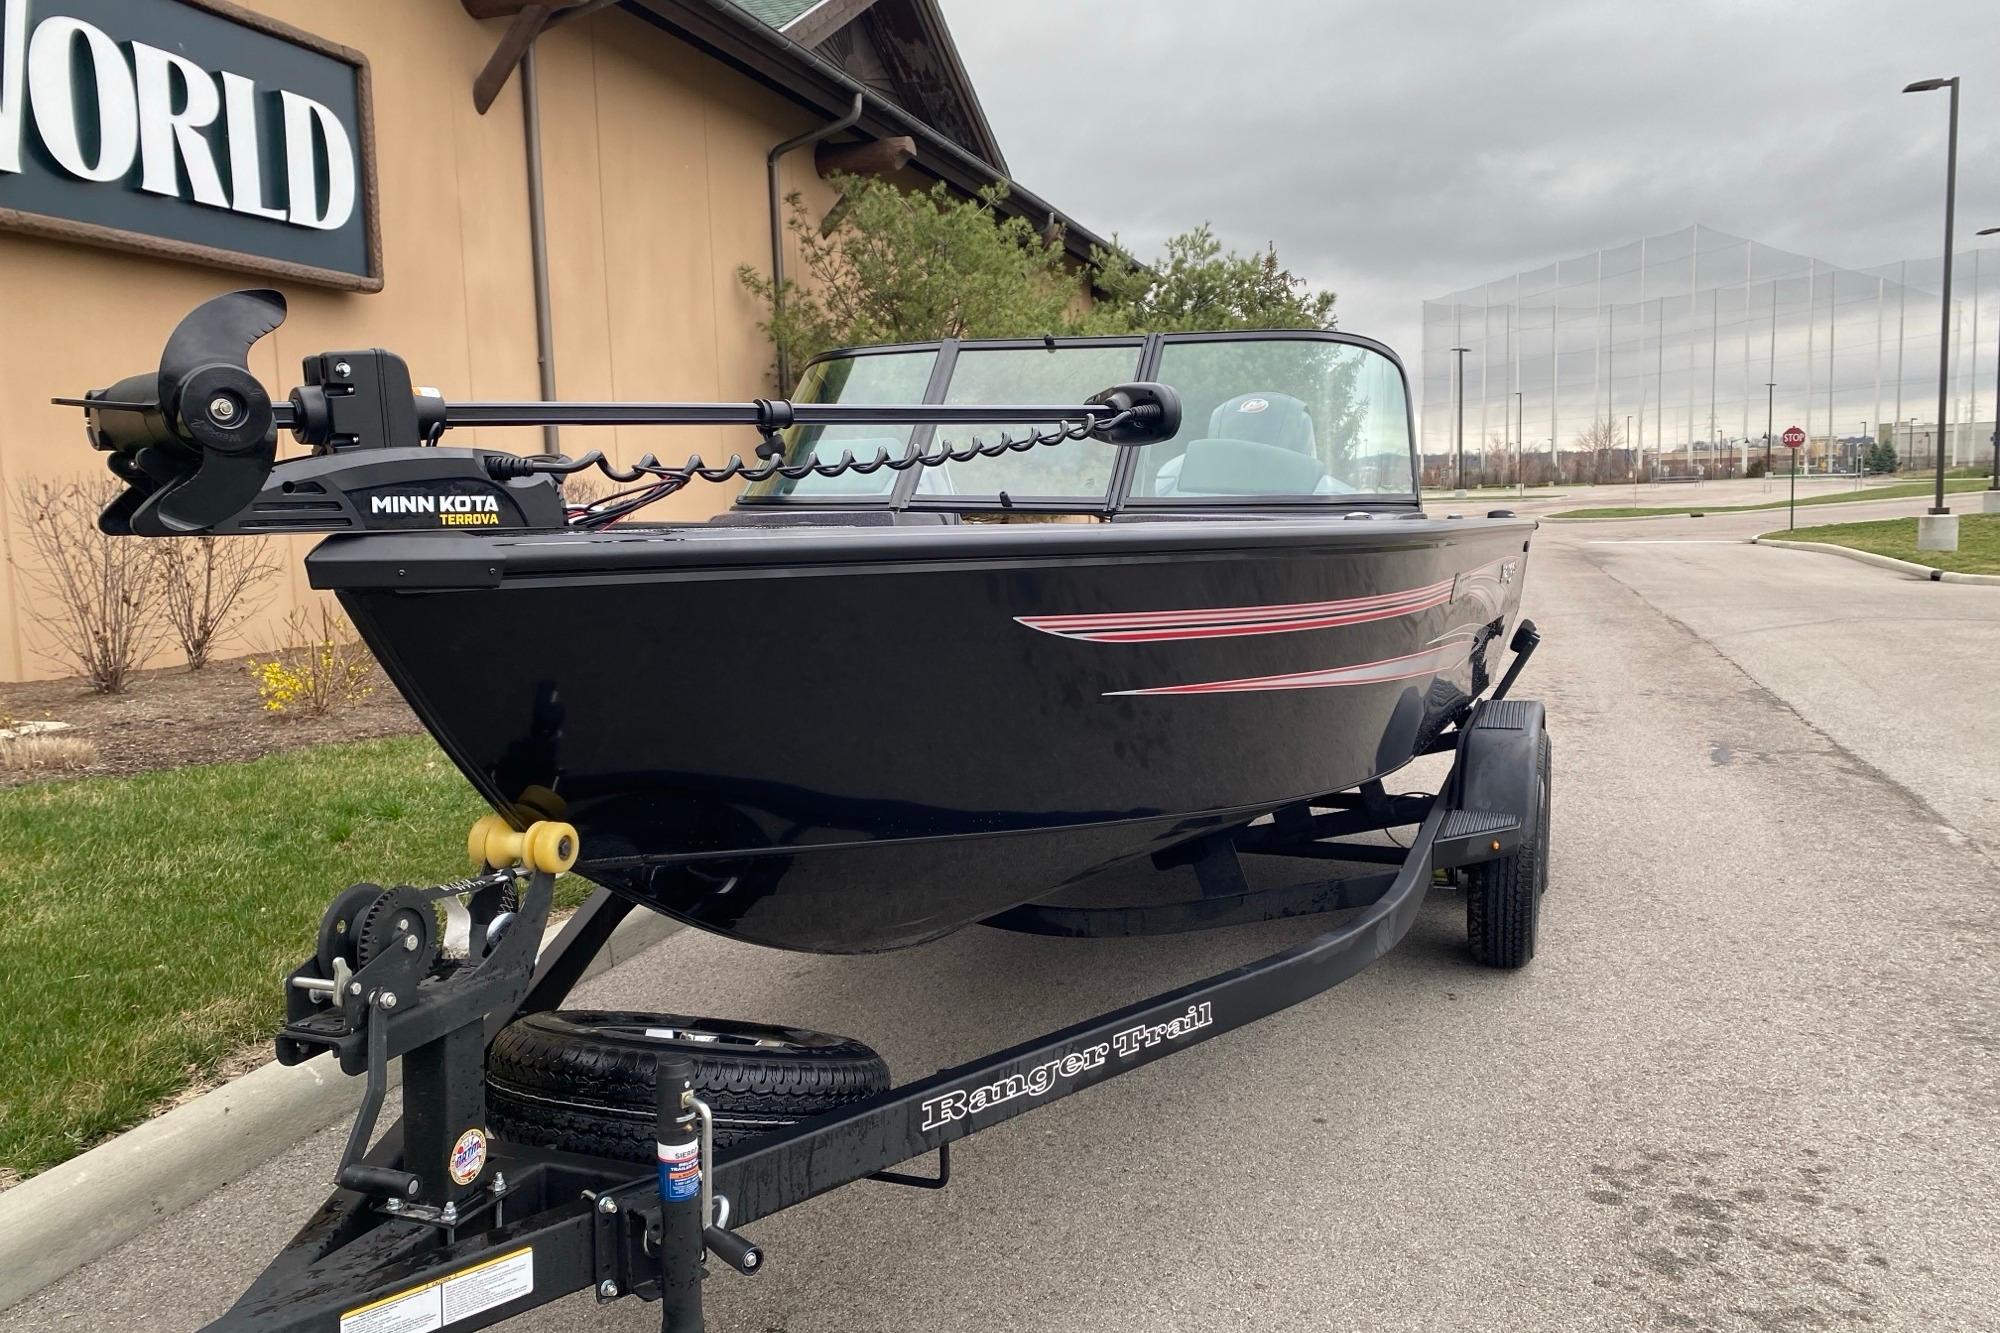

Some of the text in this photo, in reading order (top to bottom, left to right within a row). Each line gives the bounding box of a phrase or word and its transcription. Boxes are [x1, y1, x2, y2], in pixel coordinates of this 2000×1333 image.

[0, 0, 356, 231] ORLD
[1784, 433, 1805, 442] STOP
[371, 495, 499, 514] MINN KOTA
[439, 513, 499, 526] TERROVA
[921, 1001, 1213, 1131] Ranger Trail
